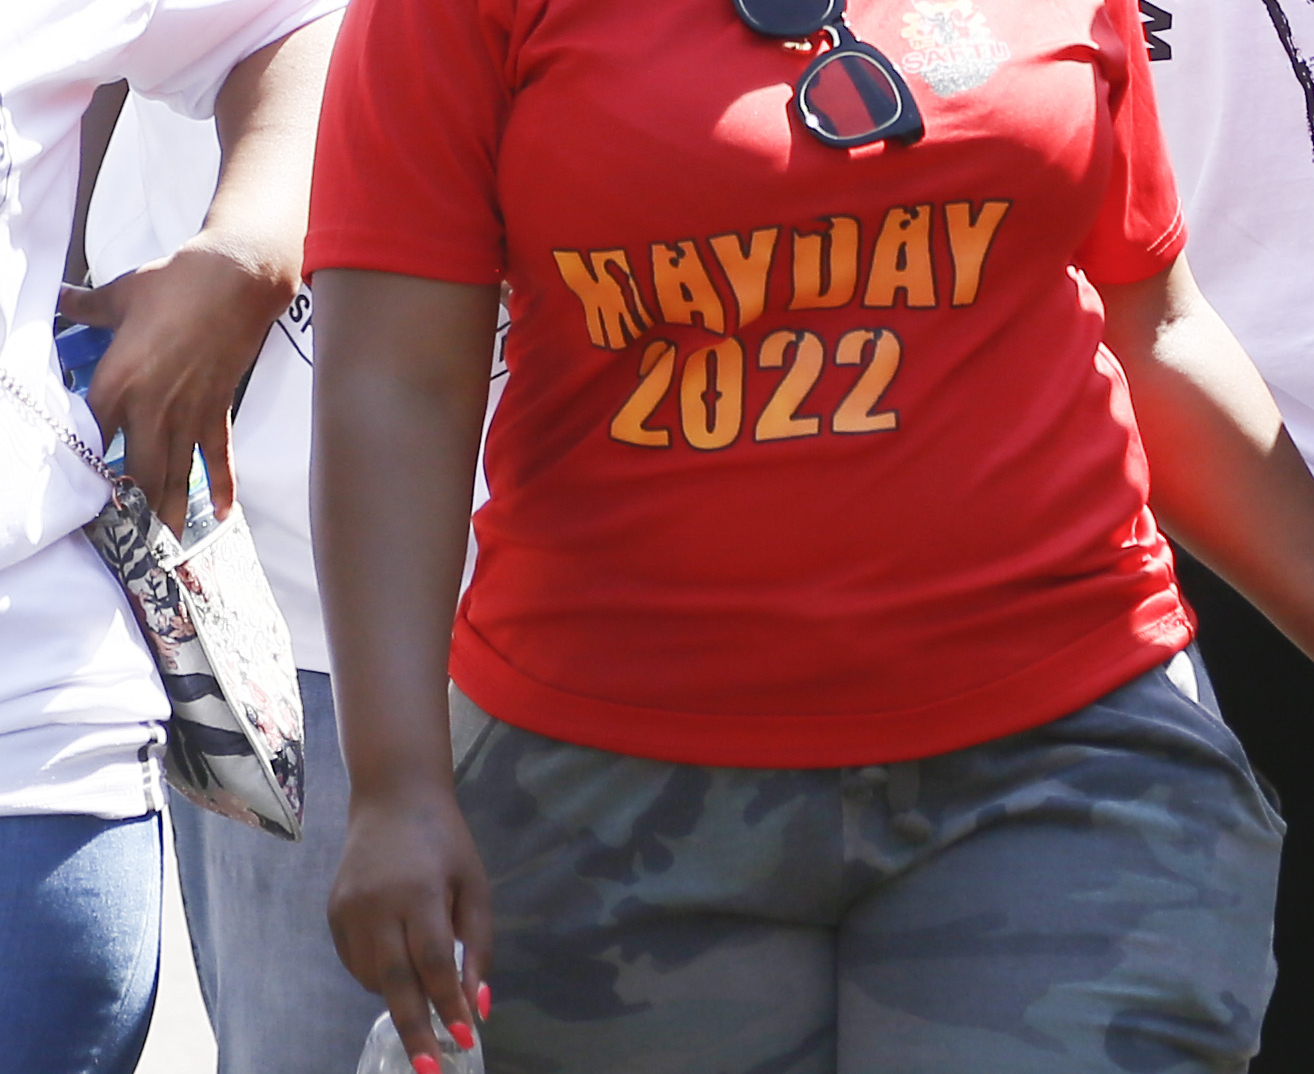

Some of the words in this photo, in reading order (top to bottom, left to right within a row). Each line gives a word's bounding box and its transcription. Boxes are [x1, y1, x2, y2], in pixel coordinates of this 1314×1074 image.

[901, 41, 1012, 74] SAFTU
[552, 197, 1013, 352] MAYDAY
[609, 327, 902, 452] 2022
